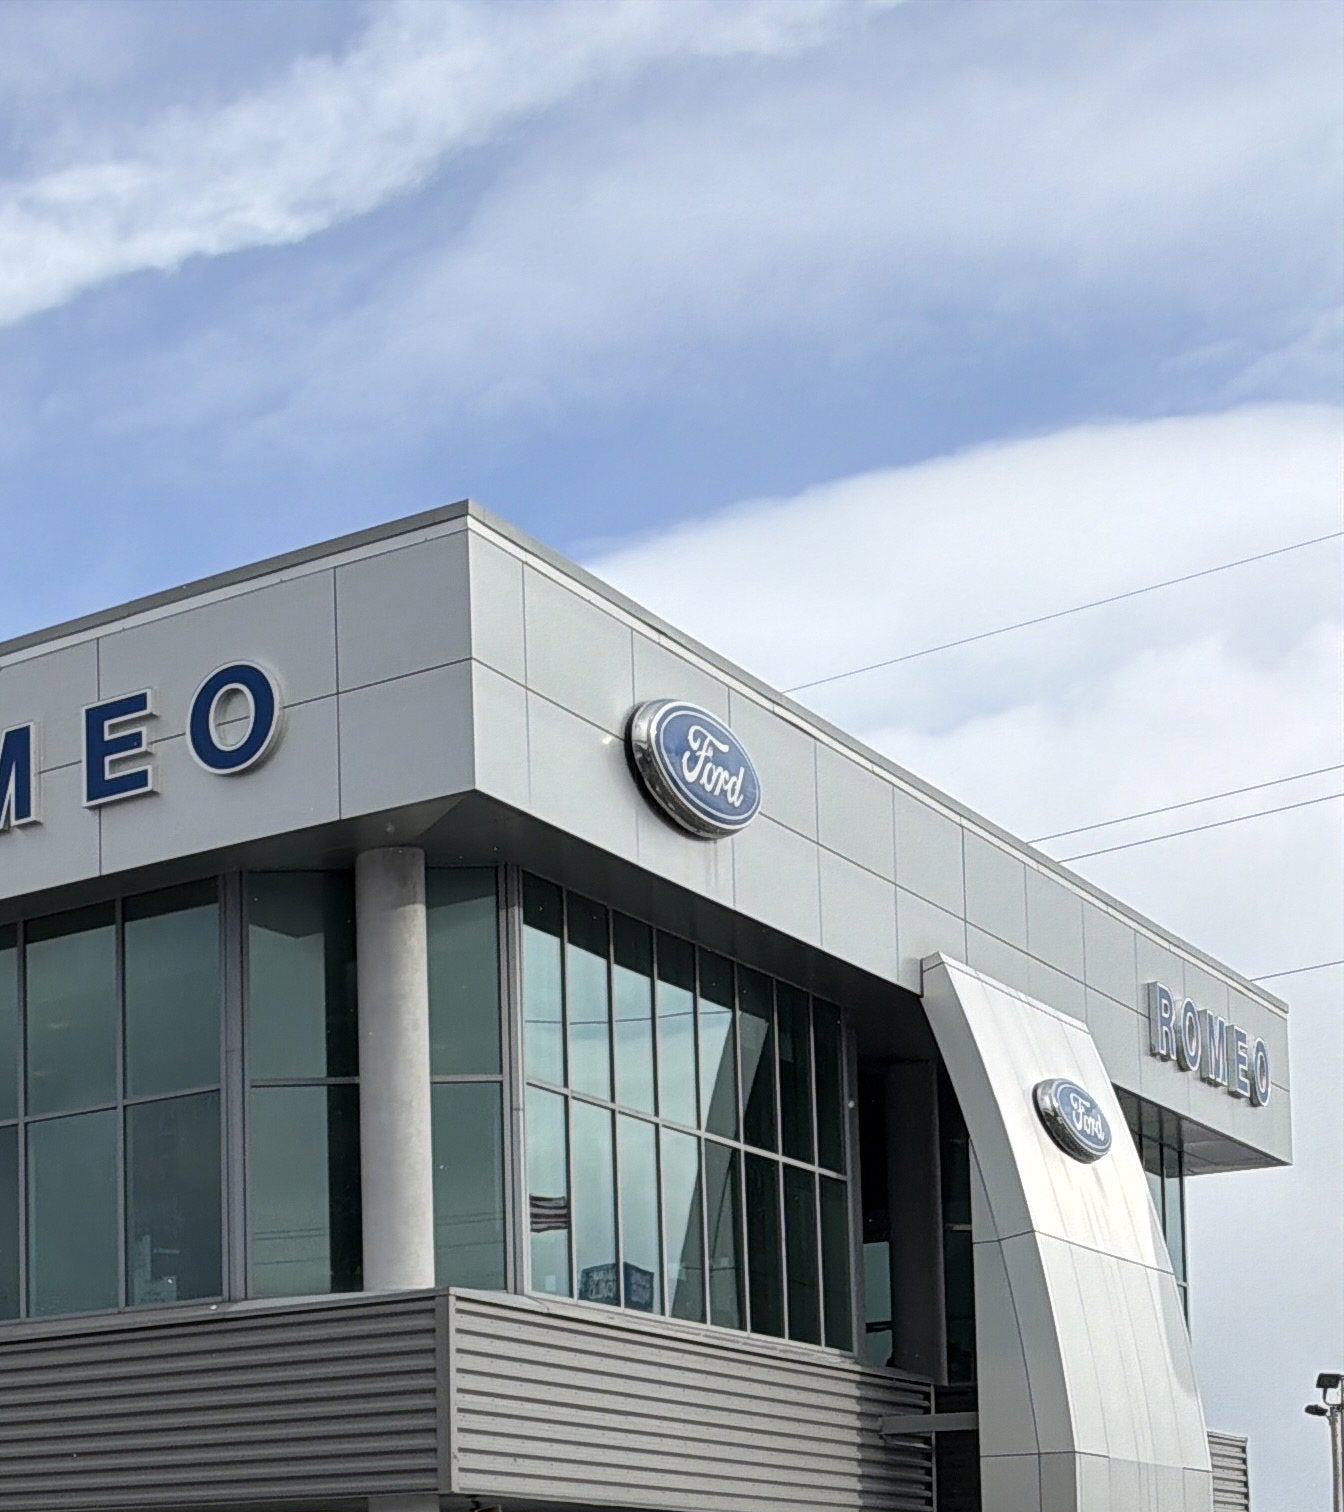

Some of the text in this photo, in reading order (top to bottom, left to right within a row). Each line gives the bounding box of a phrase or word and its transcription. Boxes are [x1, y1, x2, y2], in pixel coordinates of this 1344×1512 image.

[681, 724, 745, 807] Ford
[1149, 981, 1272, 1108] ROMEO
[1069, 1091, 1106, 1141] Ford
